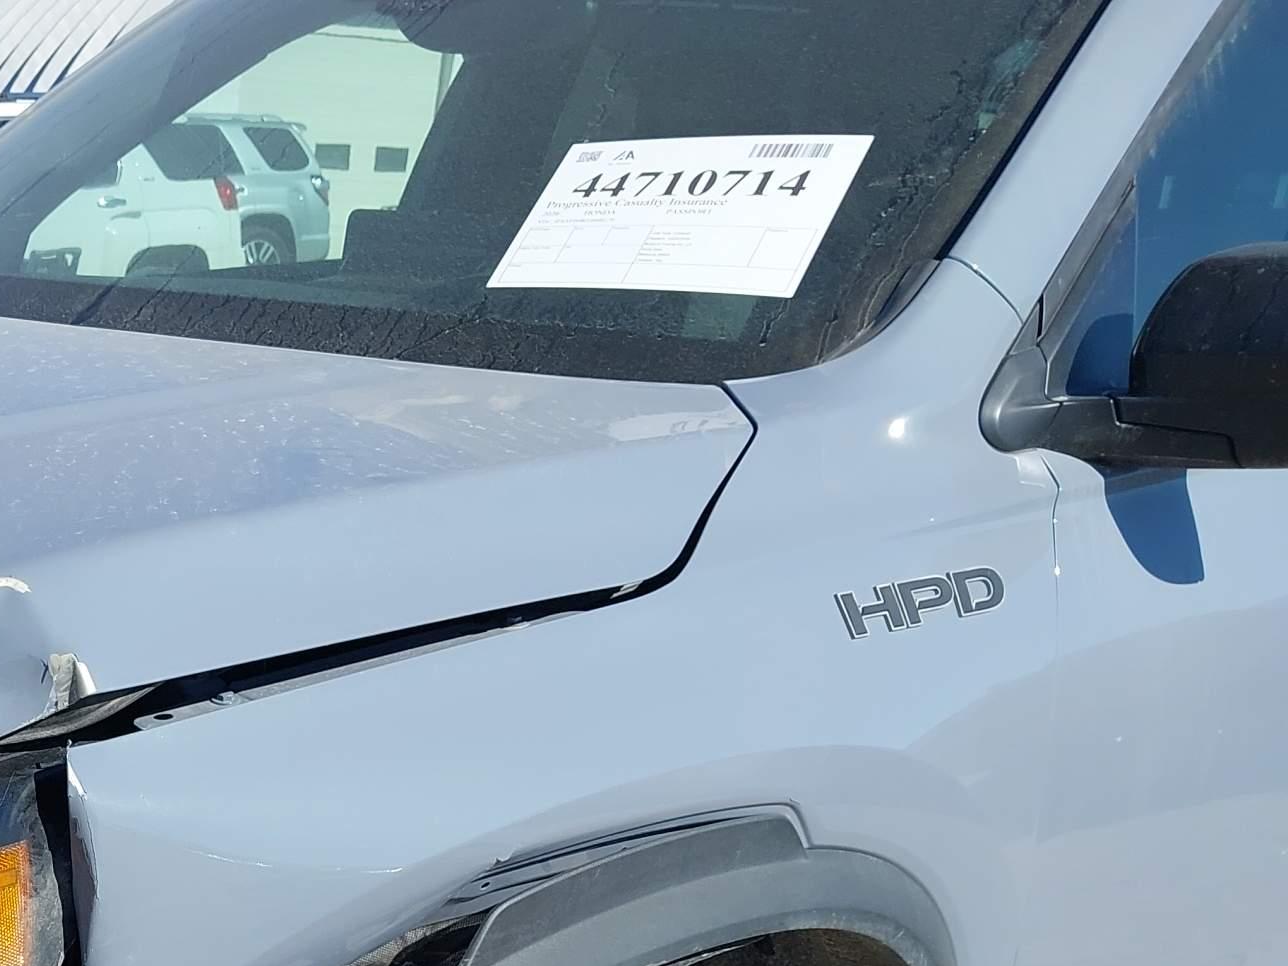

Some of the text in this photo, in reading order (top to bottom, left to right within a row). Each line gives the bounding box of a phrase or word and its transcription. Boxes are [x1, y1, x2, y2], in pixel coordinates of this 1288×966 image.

[572, 169, 811, 199] 44710714
[546, 197, 728, 209] Progressive Casualty Insurance
[833, 565, 1005, 640] HPD
